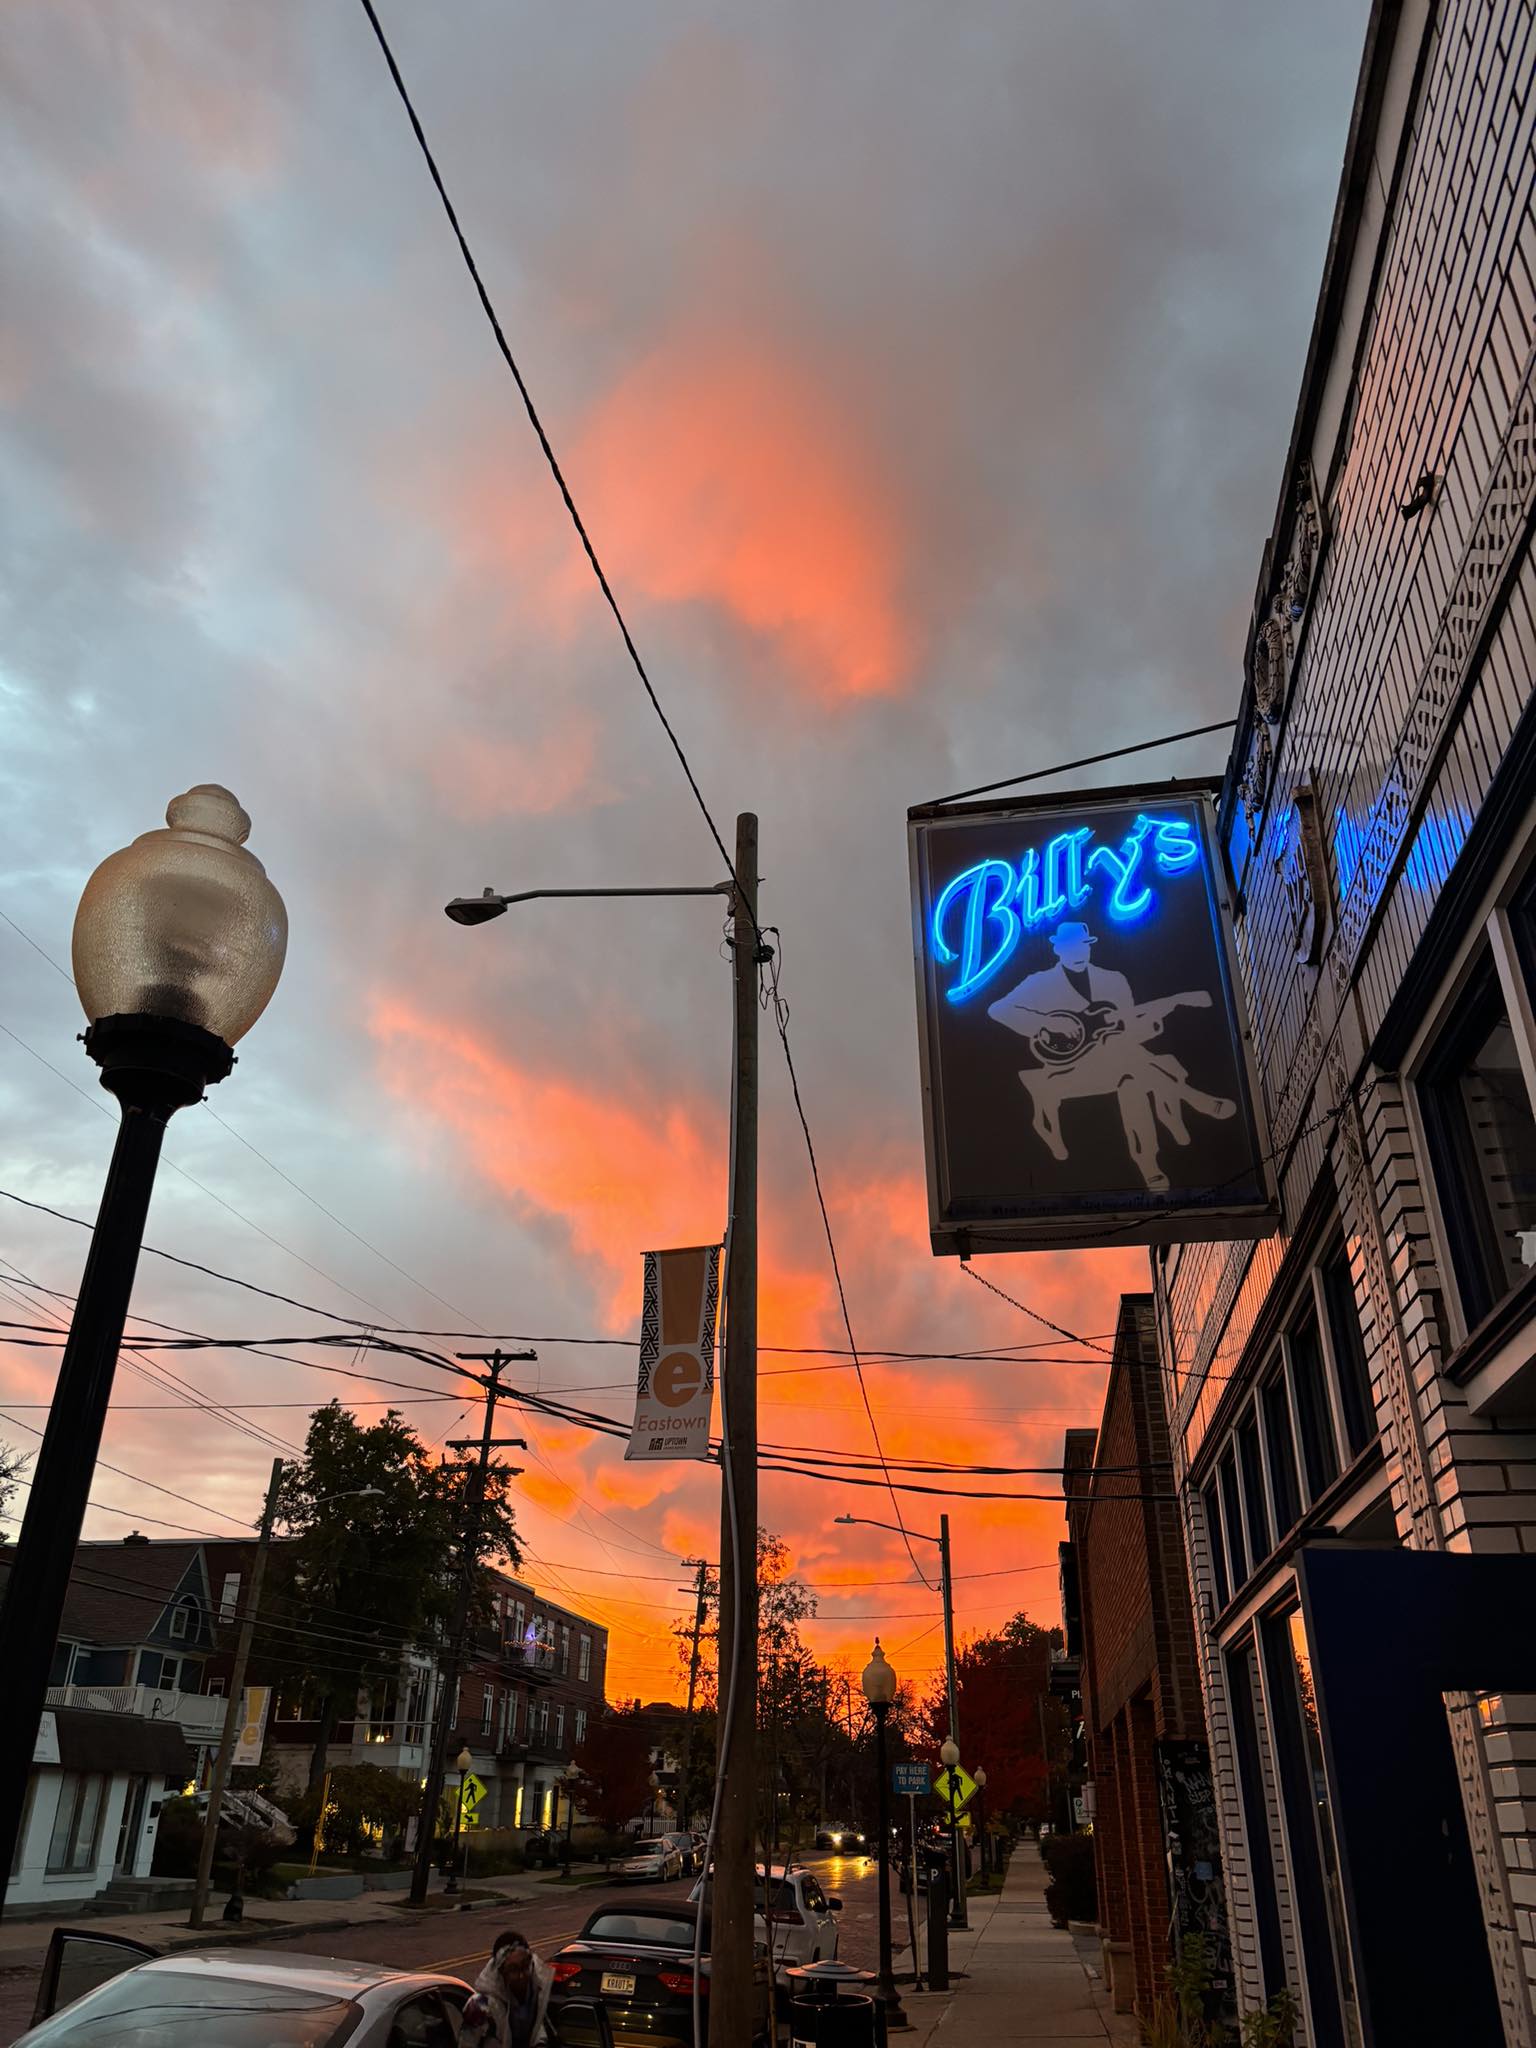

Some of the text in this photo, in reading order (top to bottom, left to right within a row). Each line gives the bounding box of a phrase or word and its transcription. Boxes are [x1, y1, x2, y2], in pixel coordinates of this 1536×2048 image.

[934, 814, 1198, 1001] Billy's
[654, 1353, 702, 1407] e
[637, 1415, 707, 1432] Eastown
[896, 1767, 927, 1775] PAY HERE
[899, 1777, 925, 1785] TO PARK
